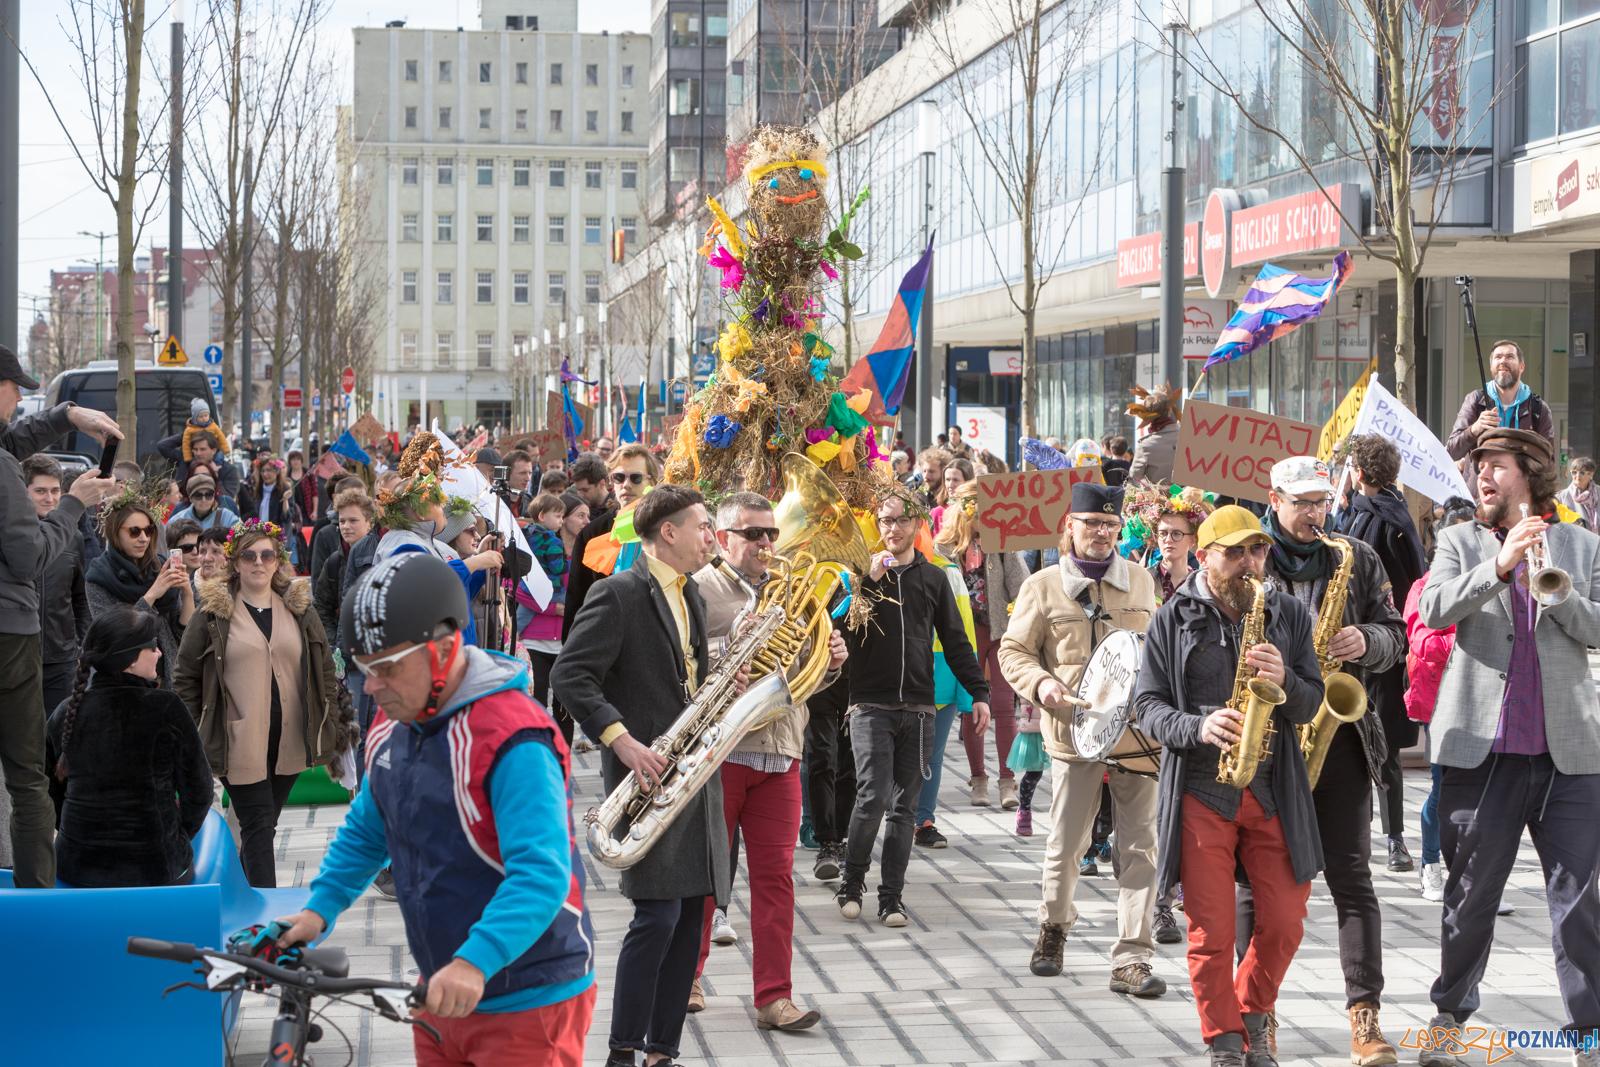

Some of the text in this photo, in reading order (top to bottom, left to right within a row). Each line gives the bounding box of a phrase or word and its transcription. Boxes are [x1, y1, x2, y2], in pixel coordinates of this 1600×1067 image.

[1533, 189, 1554, 216] empik
[1558, 168, 1578, 200] school
[1234, 200, 1337, 254] ENGLISH SCHOOL
[1118, 244, 1154, 278] ENGLISH
[1196, 335, 1218, 345] Peka
[1190, 405, 1313, 456] WITAJ
[1361, 414, 1438, 464] KULTU
[1185, 446, 1276, 490] WIOS
